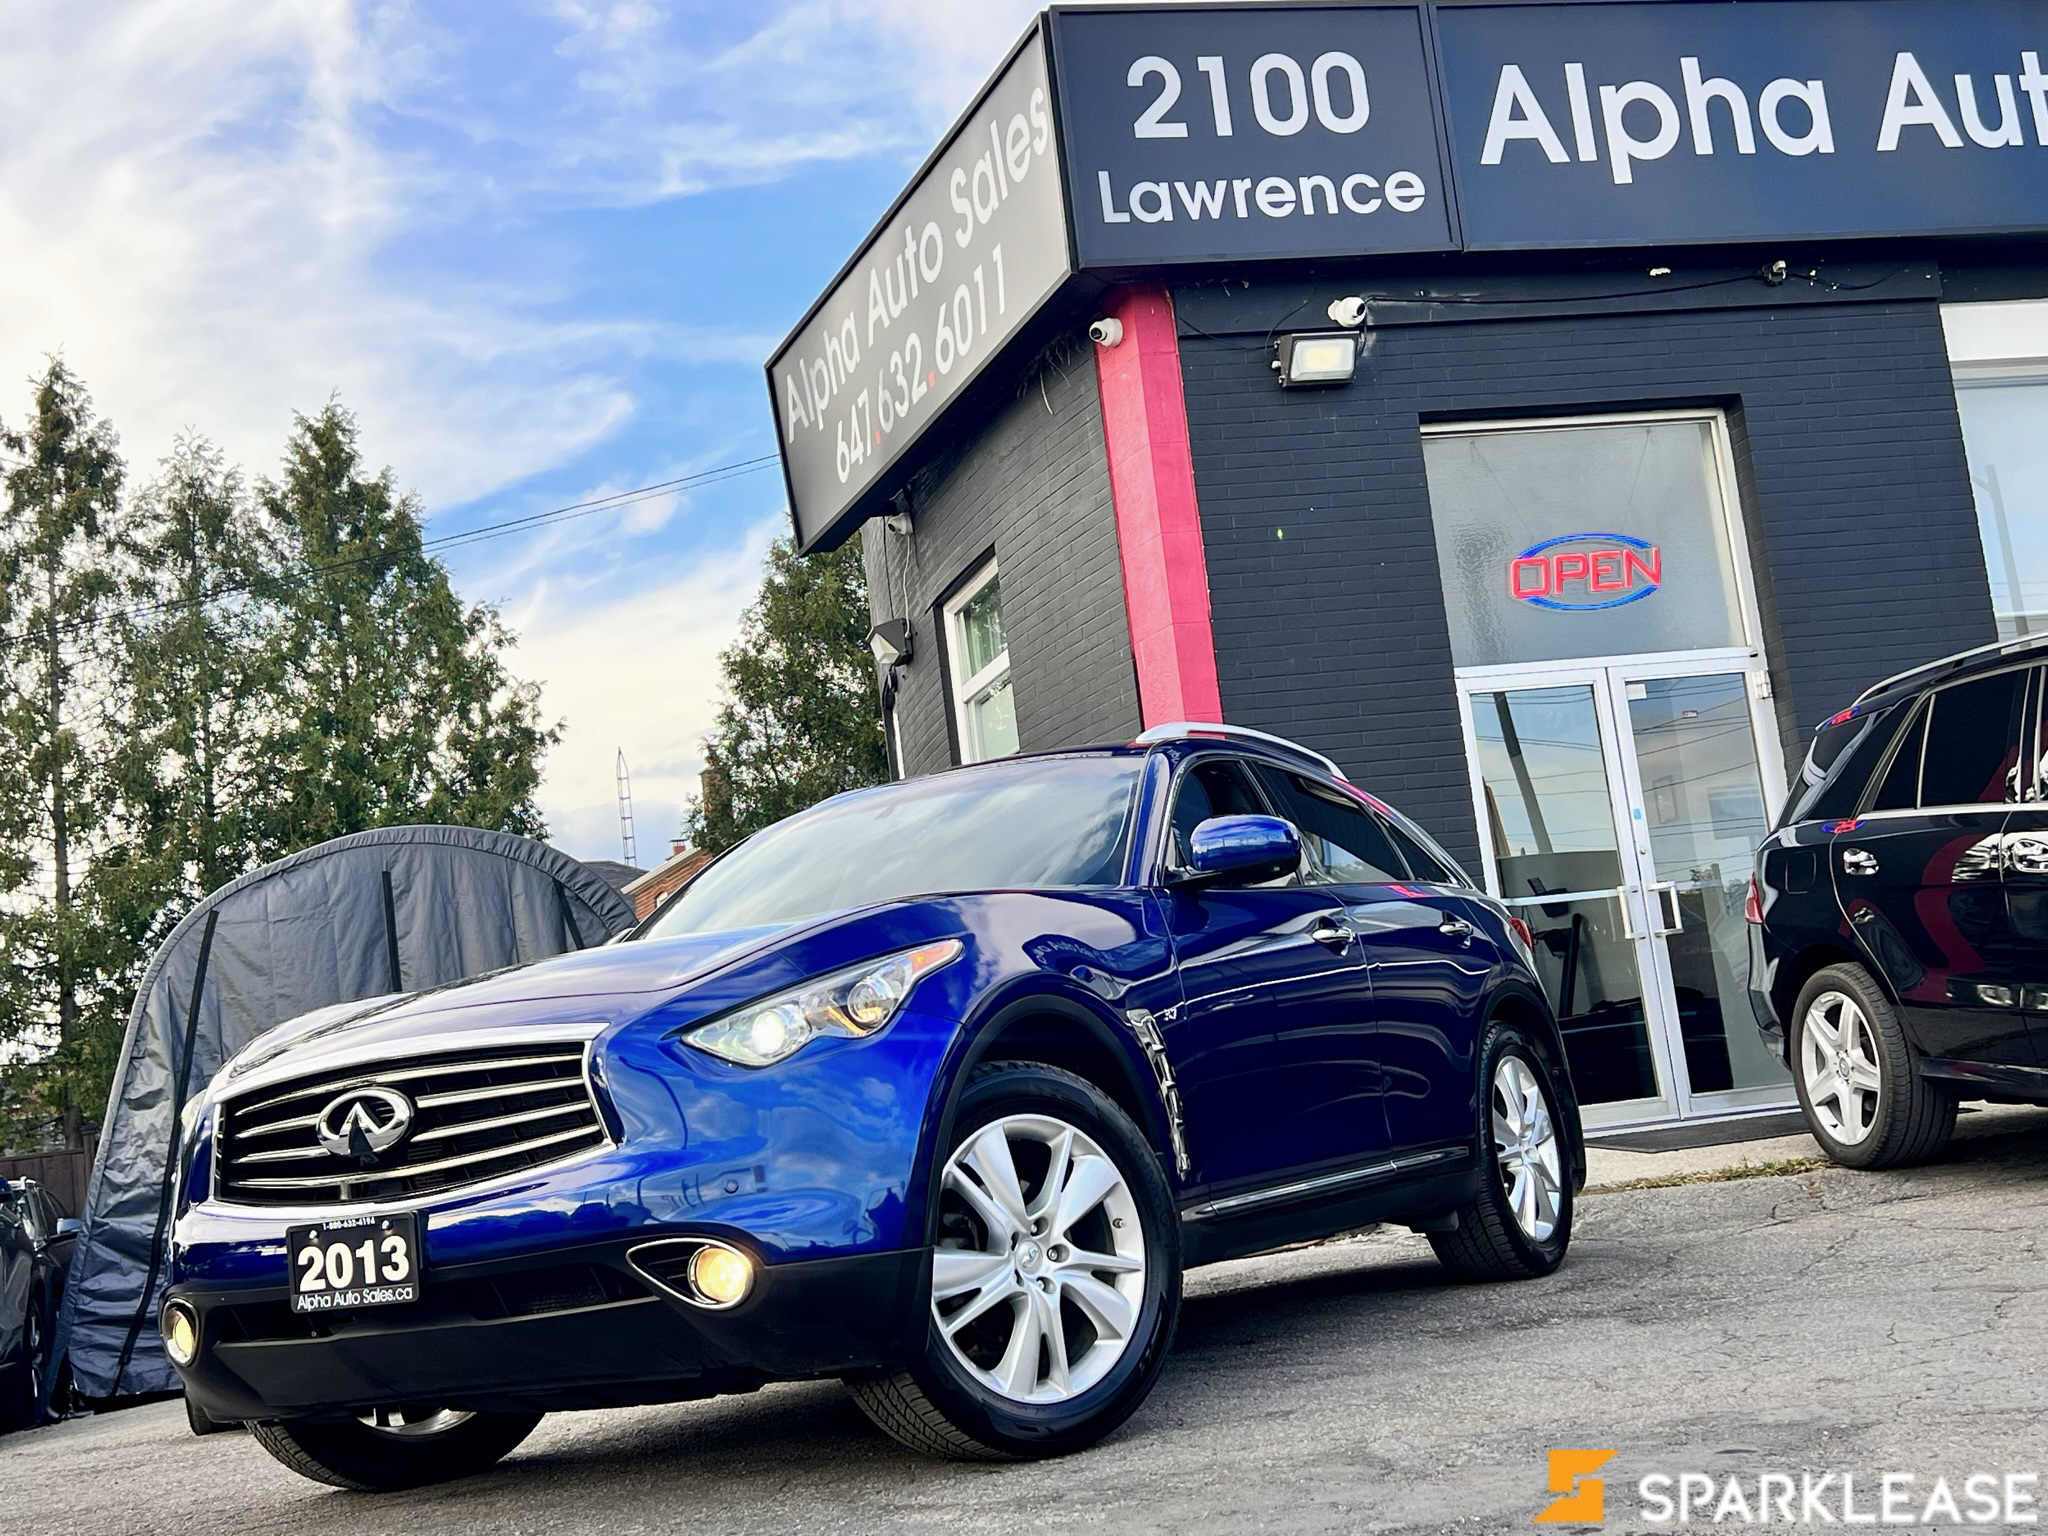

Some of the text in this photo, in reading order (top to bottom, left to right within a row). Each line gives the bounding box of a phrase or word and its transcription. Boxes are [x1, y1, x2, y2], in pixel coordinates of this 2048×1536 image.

[1126, 52, 1371, 139] 2100
[1481, 57, 1836, 184] Alpha
[1098, 170, 1425, 225] Lawrence
[786, 87, 1049, 444] Alpha Auto Sales
[836, 242, 1006, 485] 647.632.6011
[1510, 547, 1662, 600] OPEN
[297, 1235, 410, 1293] 2013
[297, 1286, 413, 1312] Alpha Auto Sales.ca
